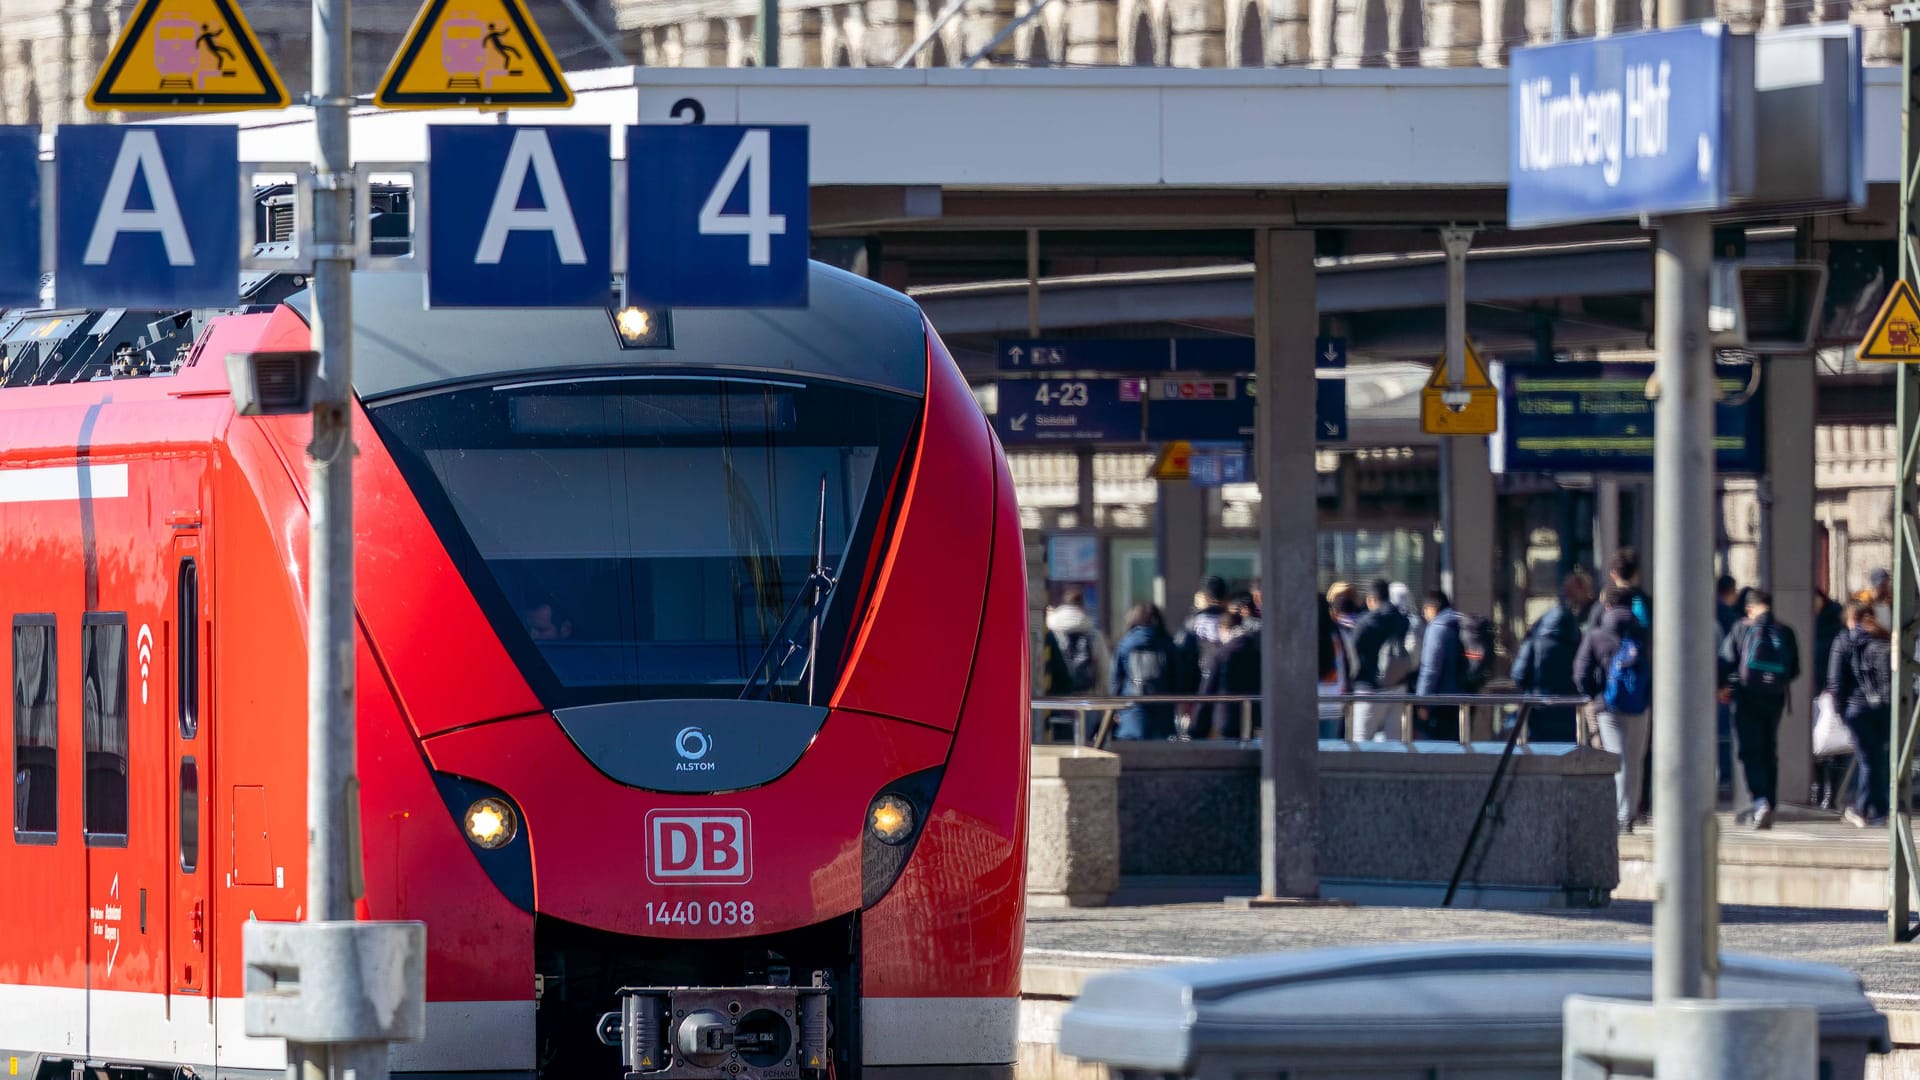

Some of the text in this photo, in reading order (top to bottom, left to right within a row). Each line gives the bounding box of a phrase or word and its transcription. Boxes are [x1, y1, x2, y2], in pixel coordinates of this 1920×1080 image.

[1519, 59, 1671, 187] Nürnberg Hbf
[84, 130, 195, 266] A
[474, 130, 587, 265] A
[699, 131, 786, 266] 4
[1035, 383, 1088, 406] 4-23
[675, 762, 715, 771] ALSTOM
[660, 822, 739, 871] DB
[646, 902, 755, 925] 1440 038
